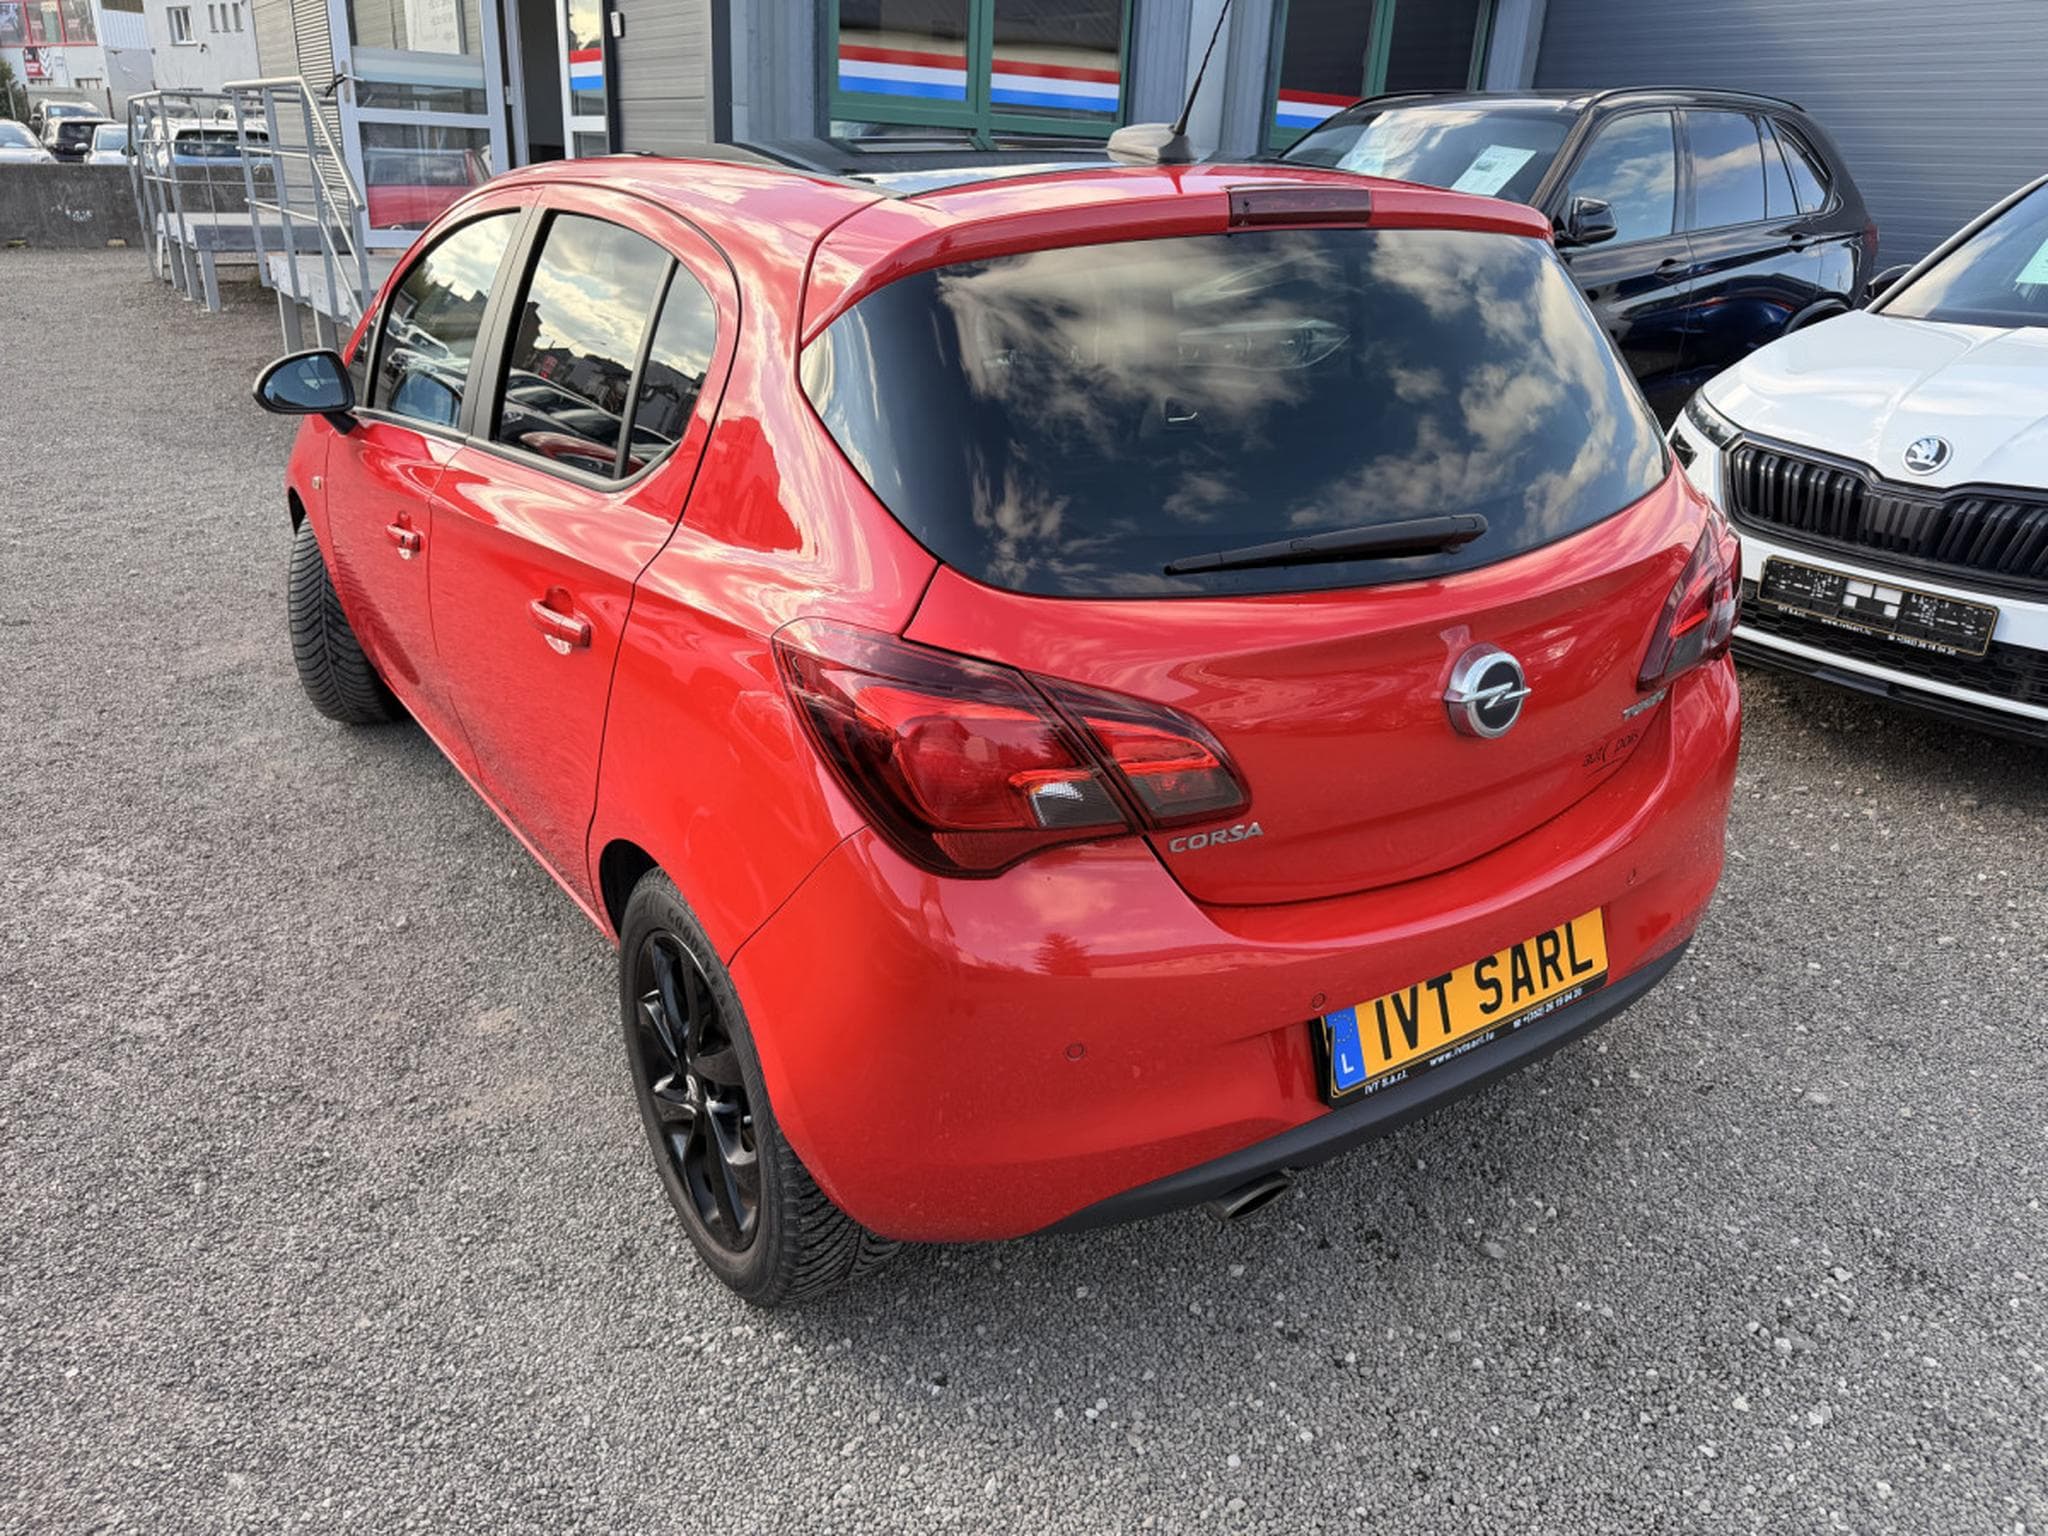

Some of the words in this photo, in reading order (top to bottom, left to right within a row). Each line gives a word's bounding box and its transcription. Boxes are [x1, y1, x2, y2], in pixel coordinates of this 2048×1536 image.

[1168, 821, 1264, 853] CORSA
[1374, 971, 1453, 1061] IVT
[1474, 921, 1594, 1015] SARL
[1340, 1052, 1355, 1075] L
[1364, 1079, 1380, 1095] IVT
